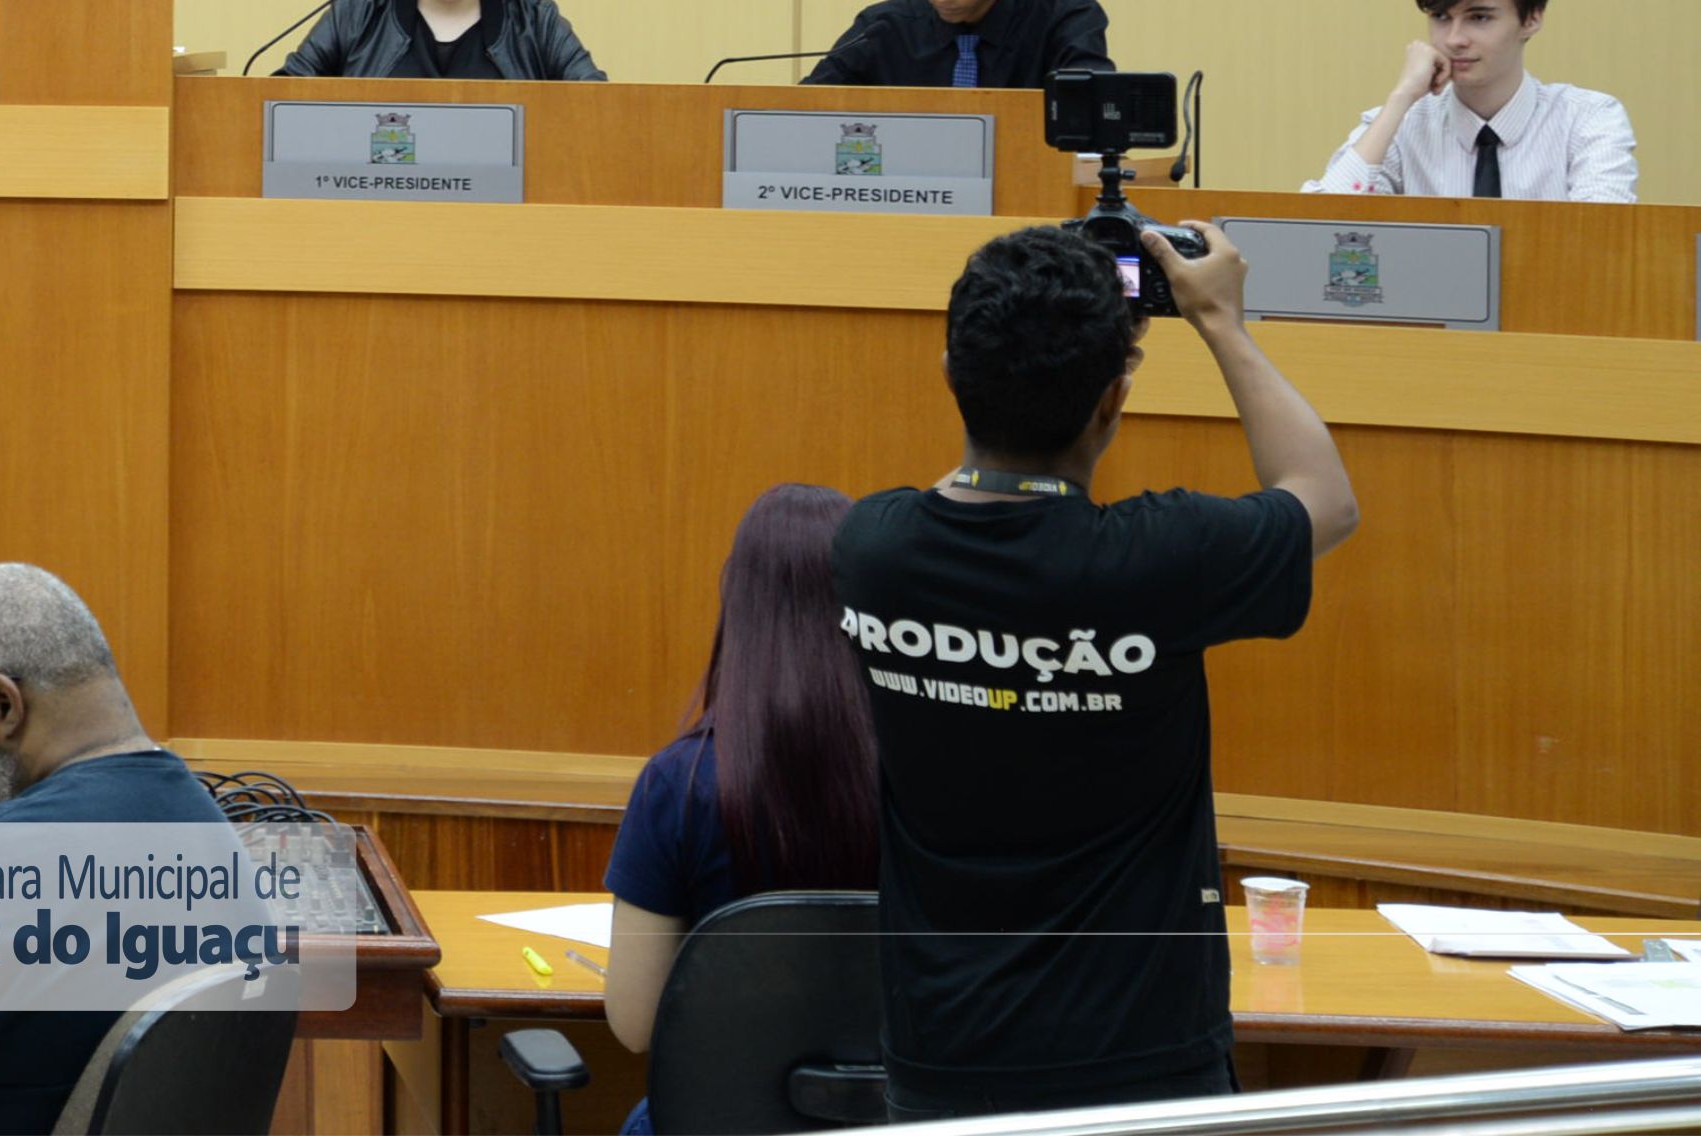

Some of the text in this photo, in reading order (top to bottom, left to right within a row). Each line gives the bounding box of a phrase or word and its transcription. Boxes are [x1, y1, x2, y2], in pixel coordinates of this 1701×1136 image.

[315, 175, 472, 191] 1º VICE-PRESIDENTE
[758, 185, 953, 205] 2º VICE-PRESIDENTE
[869, 667, 1123, 713] WWW.VIDEOUP.COM.BR
